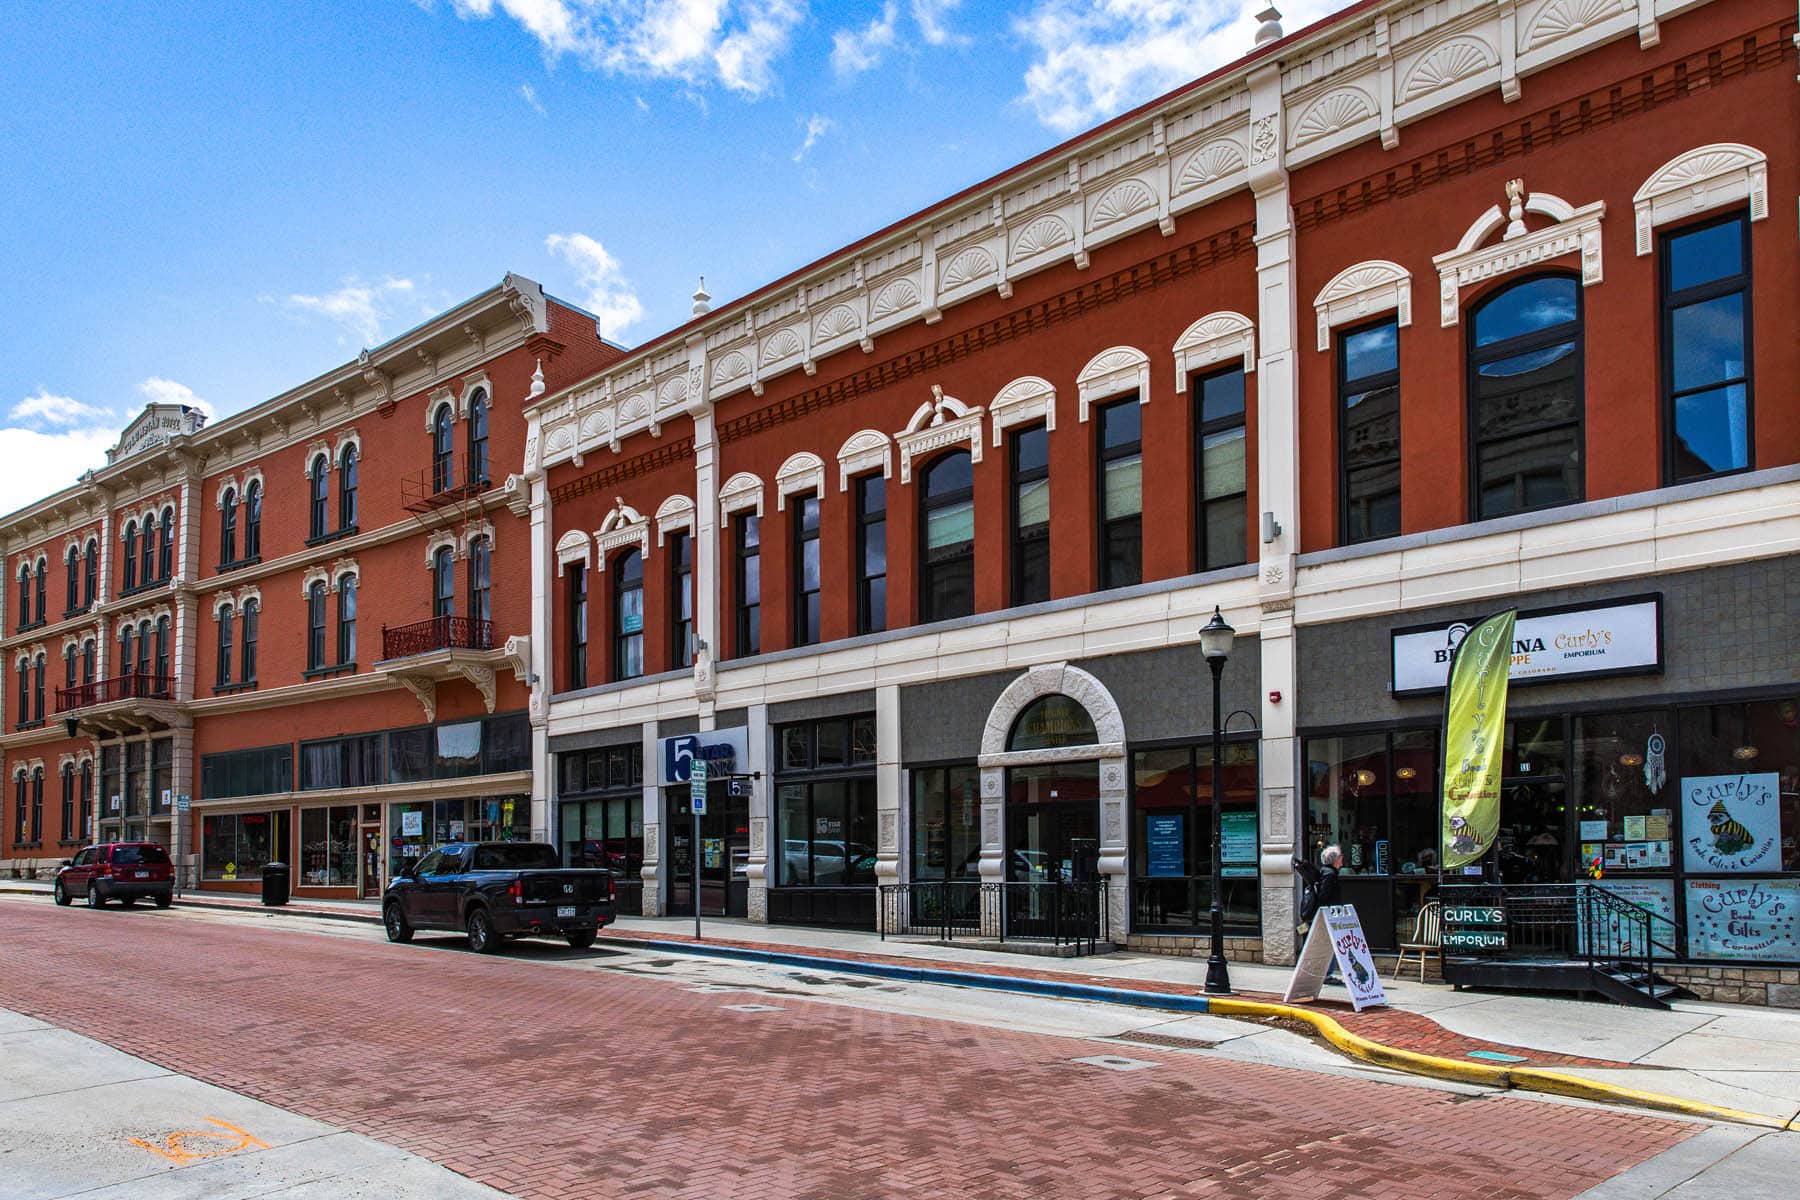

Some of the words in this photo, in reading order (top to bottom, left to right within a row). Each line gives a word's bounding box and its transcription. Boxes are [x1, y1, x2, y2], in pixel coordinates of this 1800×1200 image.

[1554, 629, 1612, 650] Curly's
[1564, 648, 1606, 659] EMPORIUM
[674, 738, 694, 782] 5
[1691, 775, 1773, 807] Curly's
[1690, 881, 1721, 890] Clothing
[1702, 883, 1786, 916] Curly's
[1730, 909, 1756, 921] Beads
[1727, 921, 1761, 938] Gifts
[1336, 929, 1368, 955] Curly's
[1443, 935, 1505, 947] EMPORIUM
[1721, 935, 1780, 952] Curiosities
